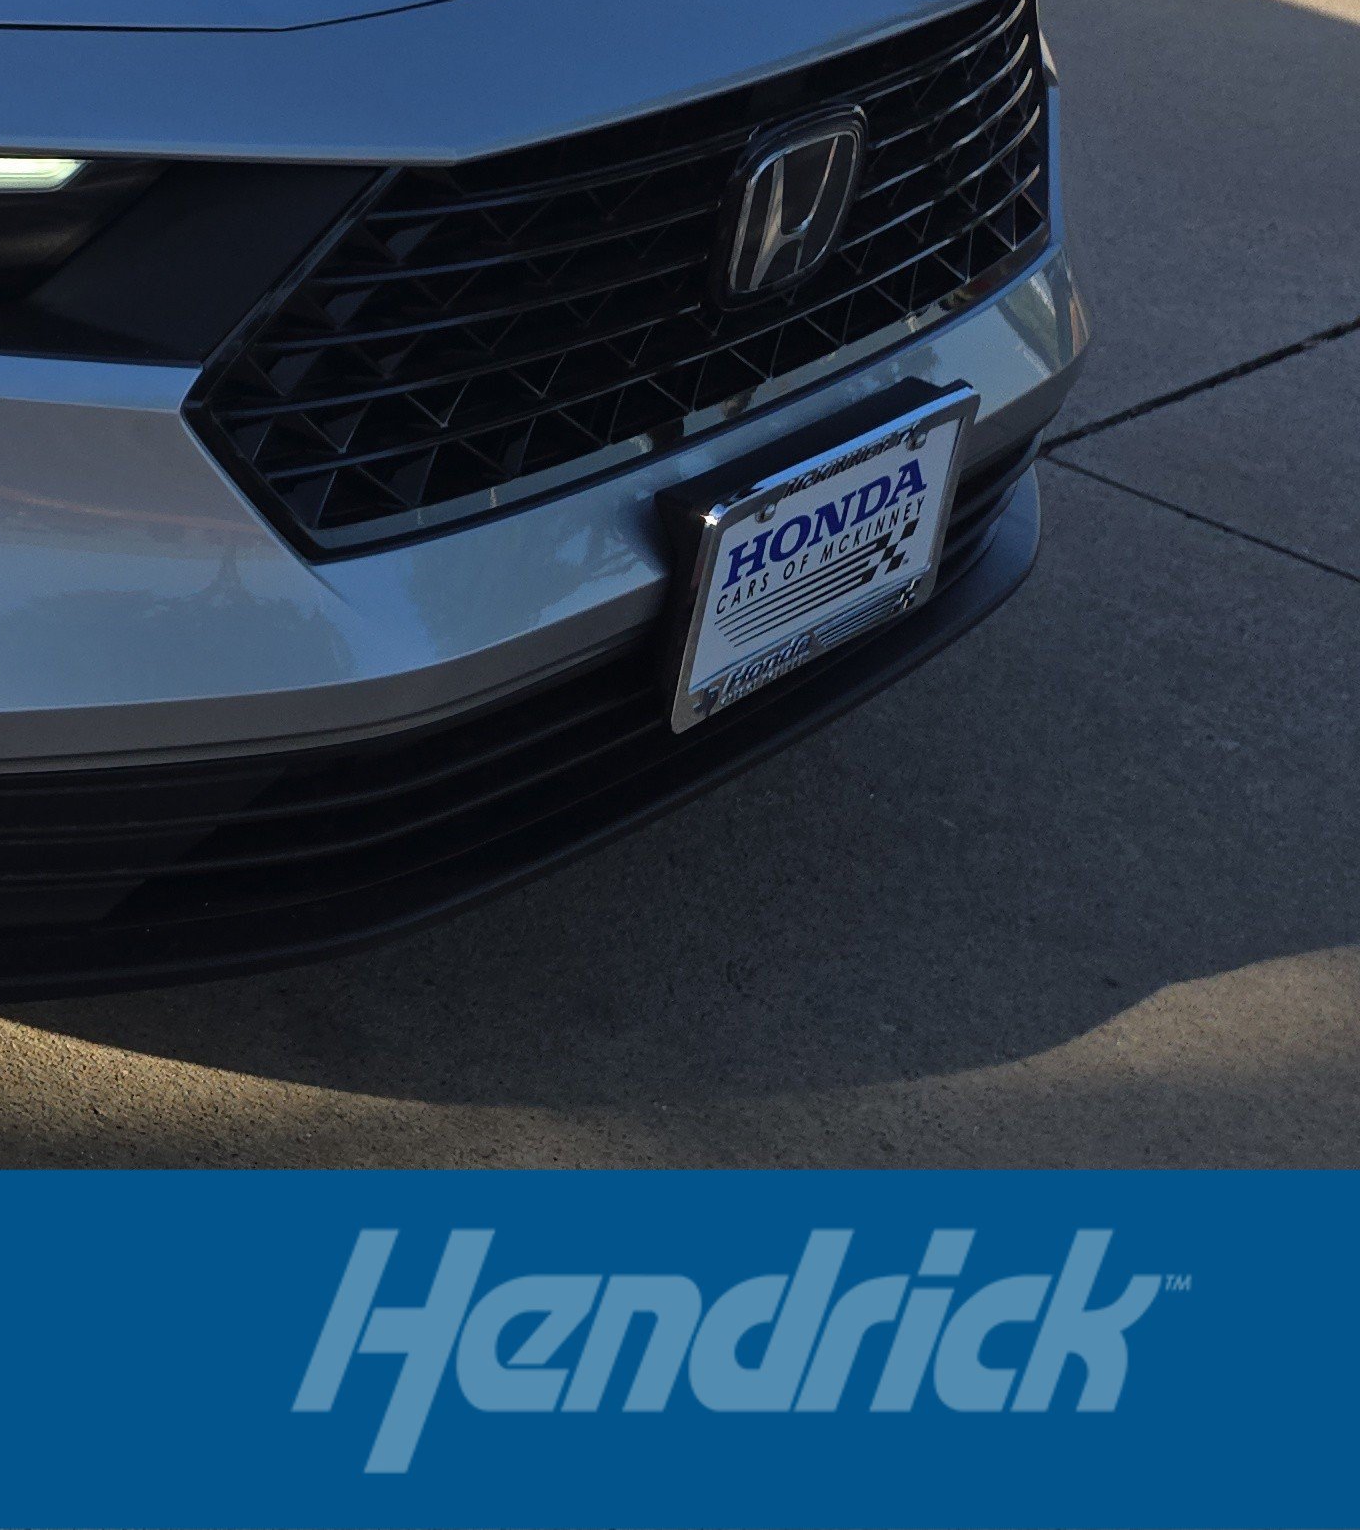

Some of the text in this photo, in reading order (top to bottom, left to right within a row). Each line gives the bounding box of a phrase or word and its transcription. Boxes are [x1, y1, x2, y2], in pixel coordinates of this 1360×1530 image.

[716, 496, 925, 615] CARS OF MCKINNEY
[721, 458, 928, 591] HONDA
